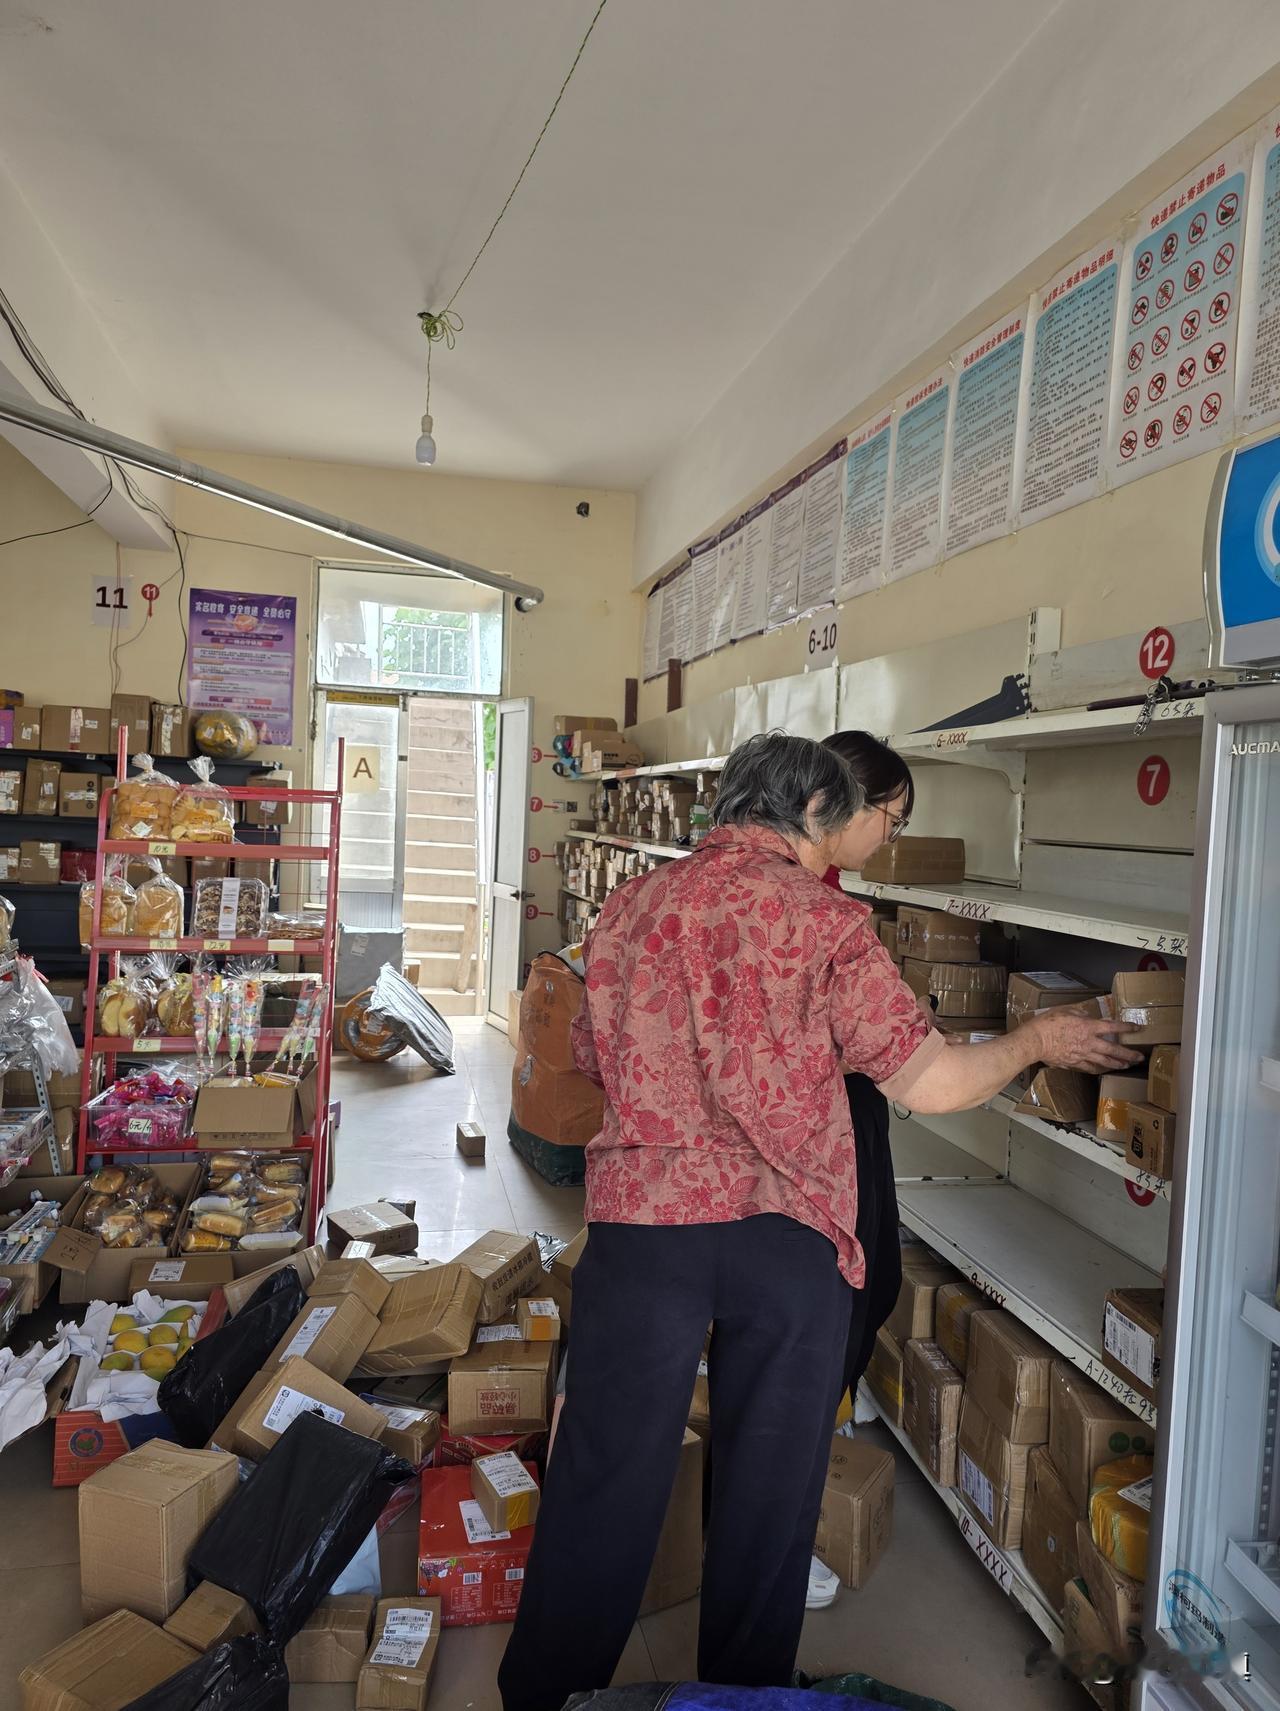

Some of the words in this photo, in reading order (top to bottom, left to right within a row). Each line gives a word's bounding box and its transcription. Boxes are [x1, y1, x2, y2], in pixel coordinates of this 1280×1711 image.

[1150, 163, 1226, 230] 快递禁止寄递物品
[95, 585, 128, 610] 11
[144, 586, 157, 599] 11
[808, 622, 837, 655] 6-10
[1142, 634, 1169, 671] 12
[353, 756, 374, 779] A
[1146, 763, 1163, 798] 7
[531, 798, 539, 810] 7
[529, 849, 537, 861] 8
[527, 906, 535, 918] 9
